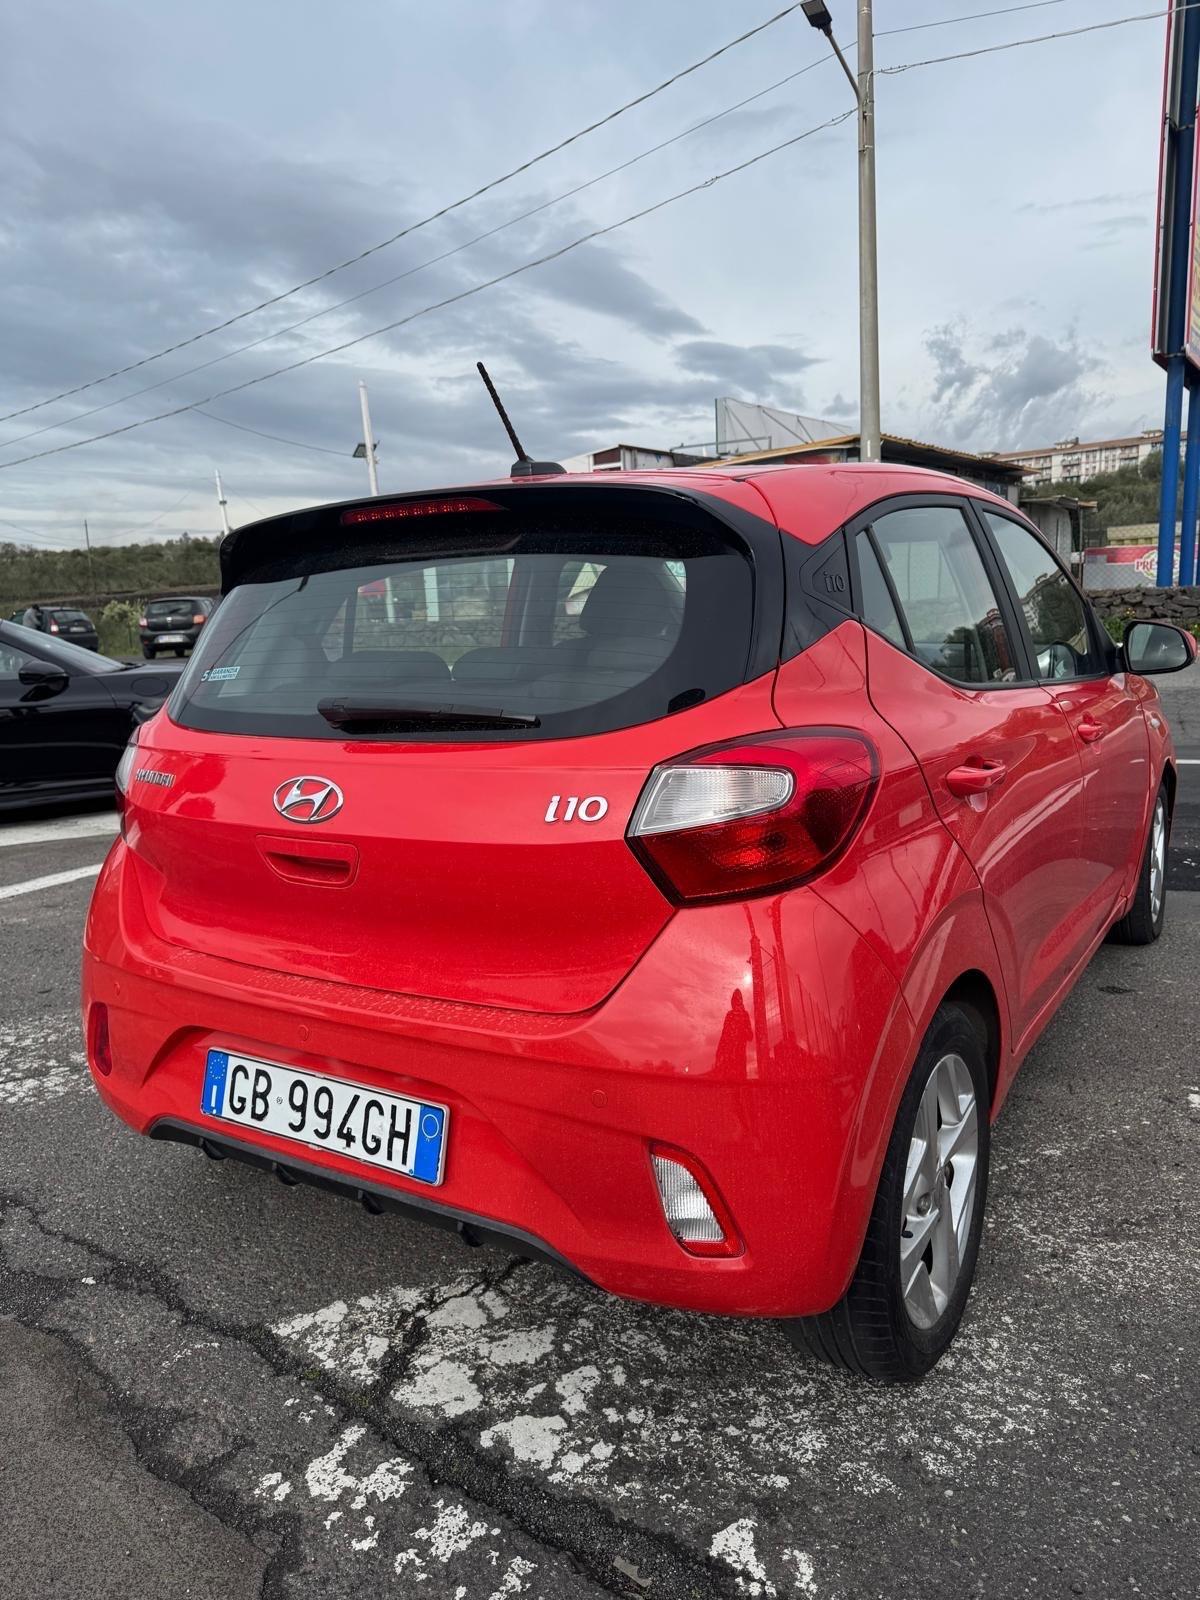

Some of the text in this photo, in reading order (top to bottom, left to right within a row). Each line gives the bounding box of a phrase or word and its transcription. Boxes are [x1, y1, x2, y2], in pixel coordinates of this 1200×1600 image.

[823, 571, 846, 593] i10
[545, 795, 609, 822] i10
[229, 1064, 412, 1166] GB 994GH
